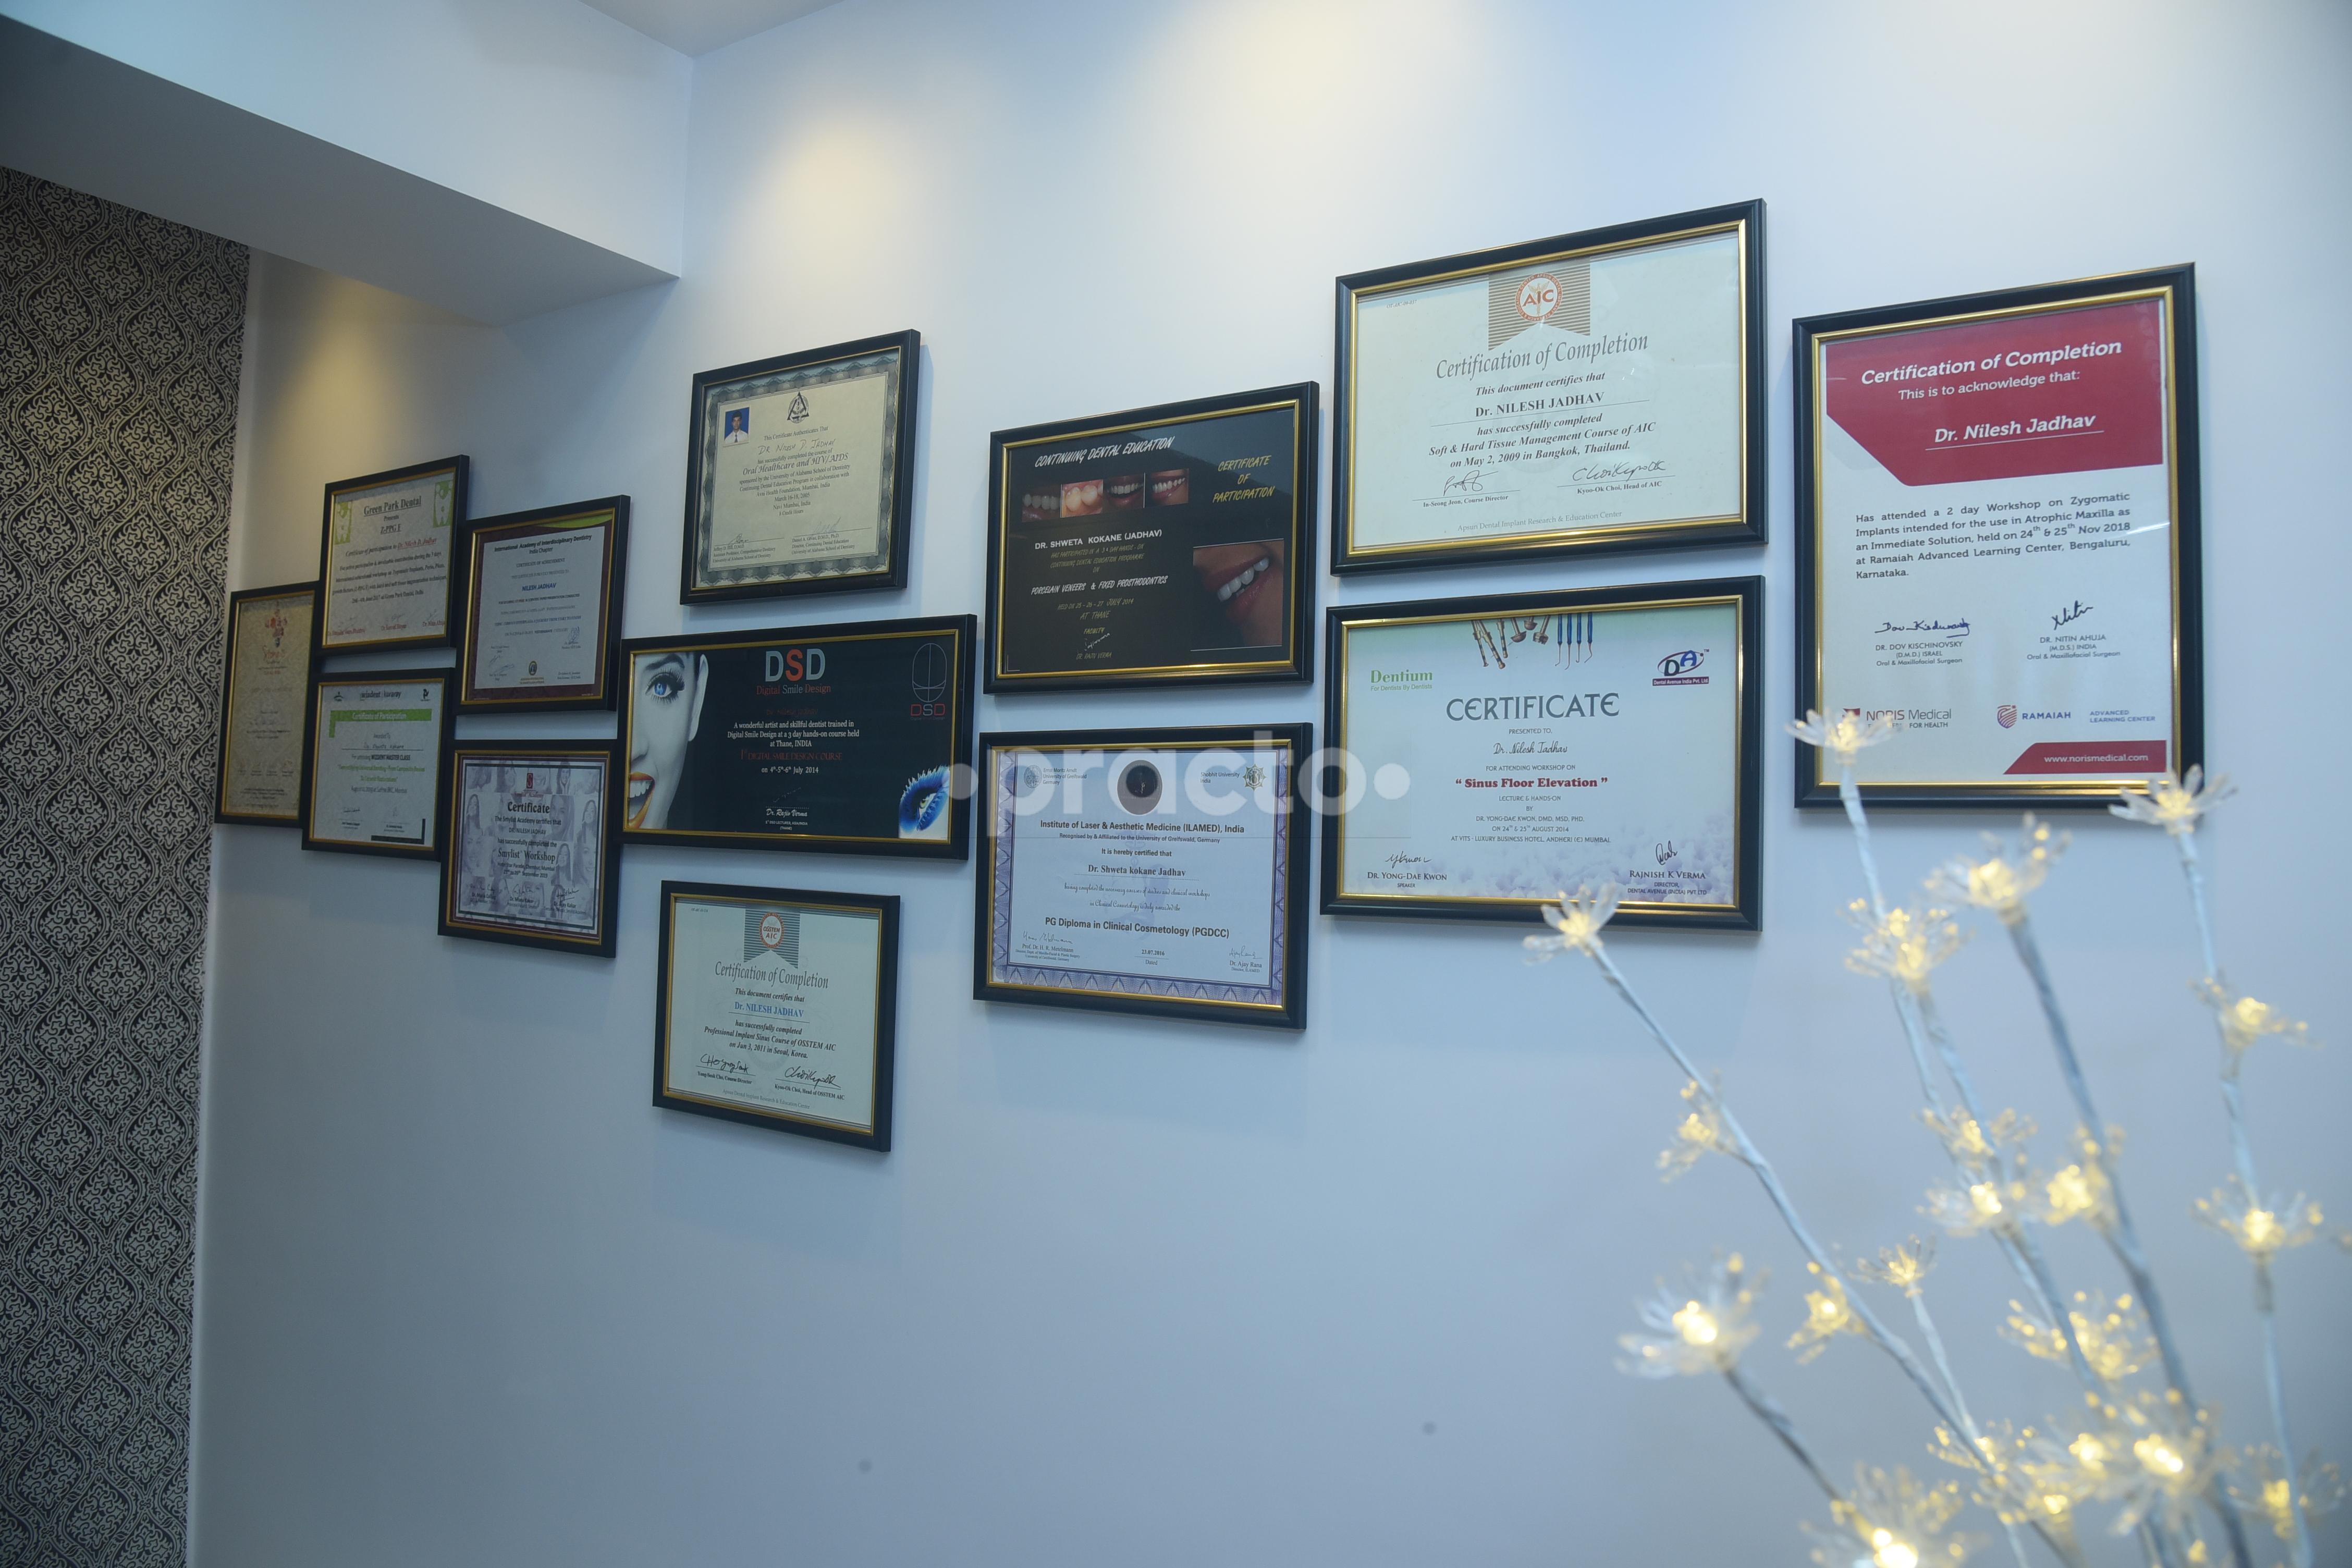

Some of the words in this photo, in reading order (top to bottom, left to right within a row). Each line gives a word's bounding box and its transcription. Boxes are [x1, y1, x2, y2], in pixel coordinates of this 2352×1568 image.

[1522, 289, 1554, 307] AIC
[1437, 349, 1530, 380] Certification
[1536, 343, 1552, 371] of
[1555, 333, 1648, 364] Completion
[1861, 360, 1975, 384] Certification
[1981, 353, 2002, 370] of
[2005, 342, 2121, 366] Completion
[1476, 386, 1494, 396] This
[1498, 381, 1543, 393] document
[1546, 375, 1583, 387] certifies
[1586, 373, 1605, 382] that
[1898, 388, 1925, 400] This
[1928, 387, 1938, 397] is
[1942, 386, 1955, 395] to
[1958, 375, 2045, 393] acknowledge
[2049, 370, 2080, 383] that:
[1476, 408, 1492, 416] Dr.
[1497, 399, 1544, 413] NILESH
[1549, 392, 1604, 408] JADHAV
[1935, 428, 1957, 443] Dr.
[1963, 421, 2021, 439] Nilesh
[2026, 415, 2096, 433] Jadhav
[1429, 446, 1447, 457] Soft
[1450, 445, 1457, 453] &
[1461, 441, 1485, 452] Hard
[1488, 440, 1516, 449] Tissue
[1520, 432, 1581, 446] Management
[1585, 429, 1619, 438] Course
[1622, 424, 1634, 436] of
[1633, 422, 1656, 433] AIC
[1035, 449, 1087, 467] CONTINUING
[1087, 444, 1121, 460] DENTAL
[1122, 436, 1175, 454] EDUCATION
[1464, 457, 1484, 467] May
[1487, 455, 1494, 464] 2,
[1498, 452, 1520, 462] 2009
[1523, 451, 1532, 460] in
[1536, 446, 1579, 459] Bangkok,
[1585, 440, 1630, 454] Thailand.
[1218, 455, 1272, 471] CERTIFICATE
[1238, 473, 1250, 484] OF
[1212, 486, 1275, 503] PARTICIPATION
[364, 506, 382, 515] Green
[384, 500, 399, 512] Park
[400, 496, 421, 509] Dental
[1881, 509, 1926, 521] attended
[1961, 506, 1979, 515] day
[1987, 501, 2041, 511] Workshop
[2071, 493, 2129, 506] Zygomatic
[1050, 538, 1083, 547] SHWETA
[1088, 534, 1122, 544] KOKANE
[1124, 529, 1162, 540] (JADHAV)
[1856, 569, 1908, 579] Karnataka.
[1031, 585, 1060, 595] PORCELAIN
[1062, 583, 1086, 592] VENEERS
[1098, 580, 1115, 589] FIXED
[1117, 575, 1168, 587] PROSTHODONTICS
[1908, 641, 1963, 650] KISCHINOVSKY
[765, 648, 825, 682] DSD
[1371, 669, 1432, 683] Dentium
[757, 685, 780, 695] Digital
[782, 684, 803, 694] Smile
[805, 684, 831, 694] Design
[911, 704, 945, 716] DSD
[1447, 693, 1619, 721] CERTIFICATE
[1908, 708, 1951, 720] Medical
[2044, 754, 2148, 762] www.norismedical.com
[1465, 779, 1498, 788] Sinus
[1501, 778, 1534, 787] Floor
[1537, 778, 1597, 787] Elevation
[508, 802, 550, 814] Certificate
[1040, 820, 1069, 828] Institute
[1109, 822, 1144, 830] Aesthetic
[1146, 823, 1181, 831] Medicine
[1183, 824, 1222, 834] (ILAMED),
[524, 850, 555, 864] Workshop
[1101, 865, 1127, 874] Shweta
[1130, 866, 1156, 875] kokane
[1158, 867, 1185, 876] Jadhav
[1046, 917, 1056, 925] PG
[1059, 918, 1091, 928] Diploma
[1103, 921, 1132, 931] Clinical
[1135, 923, 1190, 937] Cosmetology
[1192, 926, 1229, 939] (PGDCC)
[715, 961, 766, 982] Certification
[768, 967, 778, 986] of
[779, 969, 828, 989] Completion
[747, 989, 771, 998] document
[773, 993, 793, 1001] certifies
[734, 1001, 744, 1010] Dr.
[746, 1003, 772, 1013] NILESH
[774, 1007, 804, 1017] JADHAV
